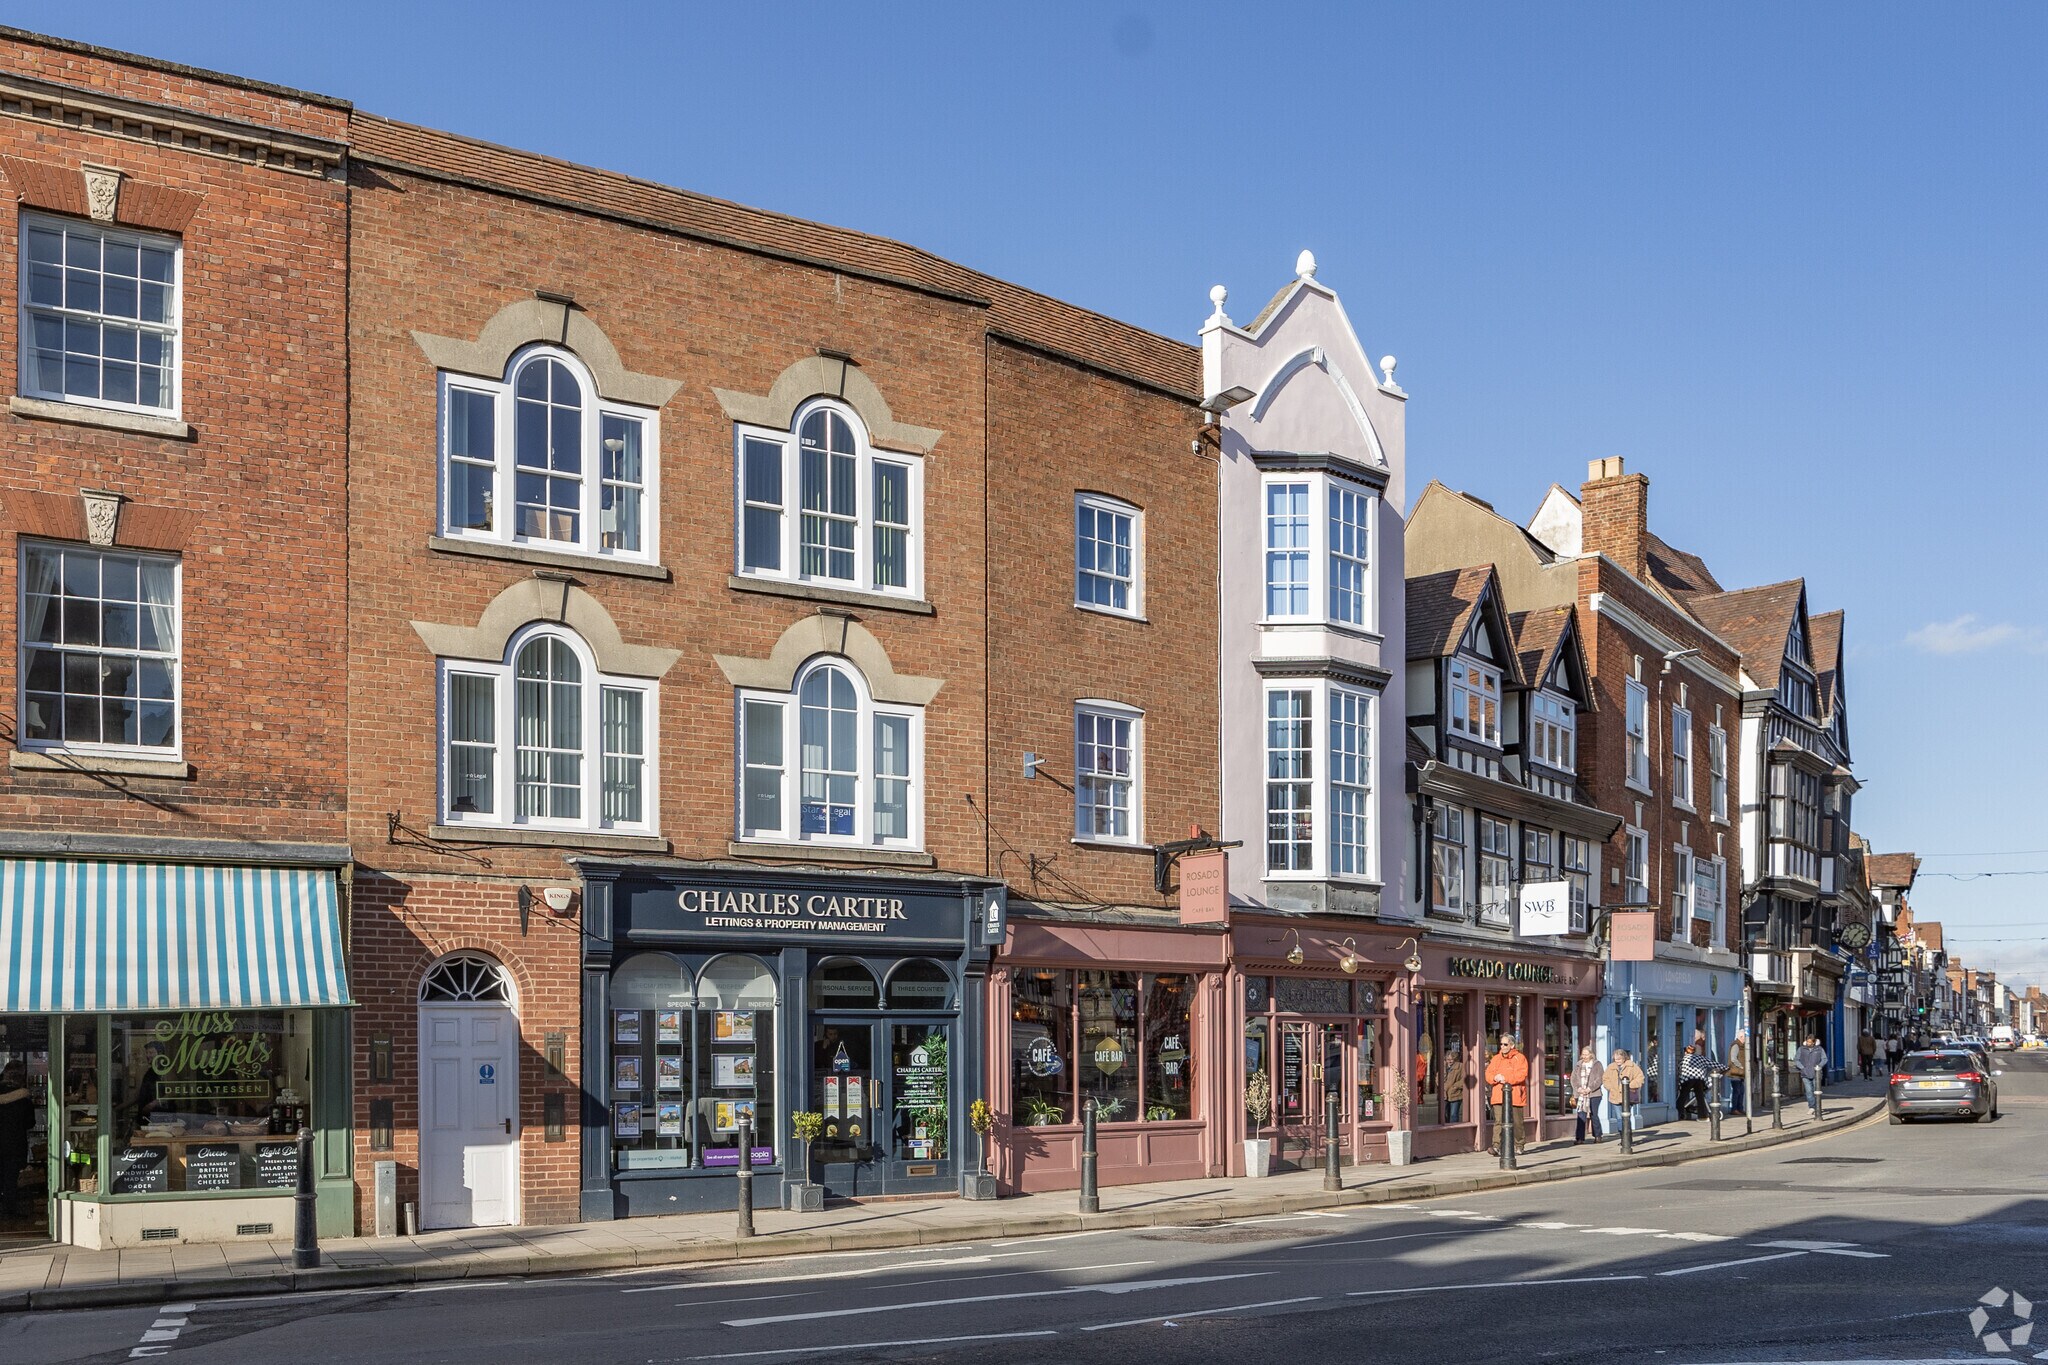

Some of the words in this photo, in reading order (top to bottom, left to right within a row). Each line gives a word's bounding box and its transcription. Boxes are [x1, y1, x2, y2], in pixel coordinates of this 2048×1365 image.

[802, 804, 820, 813] Star
[1186, 869, 1220, 882] ROSADO
[1186, 885, 1220, 897] LOUNGE
[678, 889, 800, 917] CHARLES
[806, 894, 909, 921] CARTER
[705, 916, 754, 928] LETTINGS
[755, 918, 763, 928] &
[764, 919, 817, 930] PROPERTY
[817, 922, 887, 932] MANAGEMENT
[1449, 956, 1504, 979] ROSADO
[1508, 961, 1555, 984] LOUNGE
[667, 1001, 706, 1009] SPECIALTS
[155, 1011, 238, 1042] Miss
[1164, 1034, 1180, 1049] CAFÉ
[1032, 1045, 1052, 1062] CAFÉ
[1094, 1048, 1110, 1062] CAFÉ
[1110, 1050, 1124, 1062] BAR
[1165, 1061, 1179, 1075] BAR
[165, 1085, 262, 1094] DELICATESSEN
[120, 1148, 159, 1162] Lunches
[197, 1147, 229, 1159] Cheese
[281, 1146, 297, 1156] Bit
[750, 1150, 769, 1159] oopla
